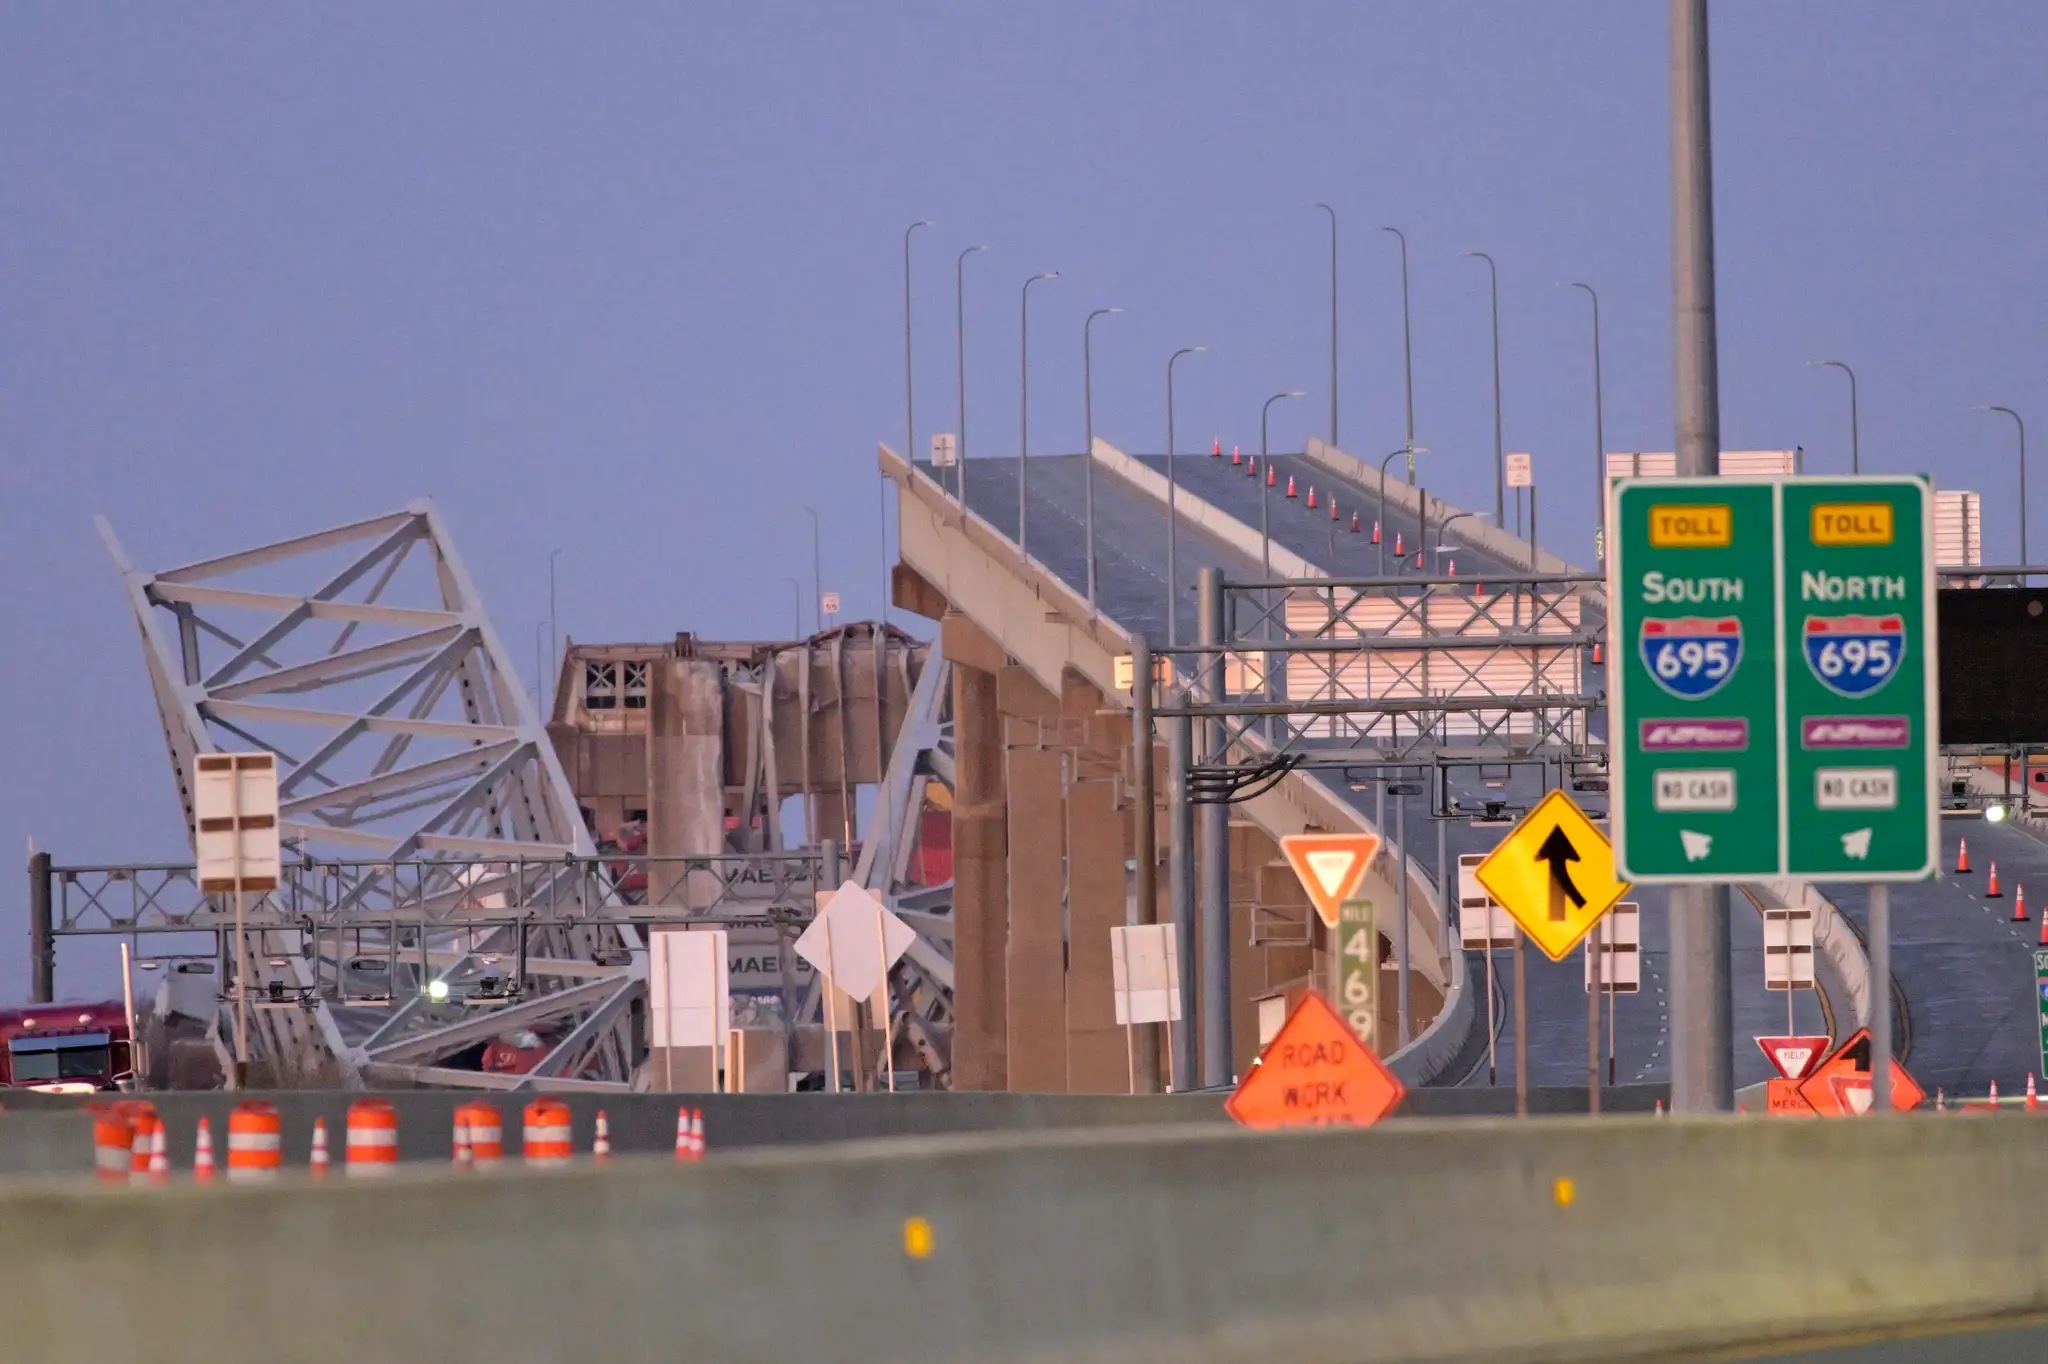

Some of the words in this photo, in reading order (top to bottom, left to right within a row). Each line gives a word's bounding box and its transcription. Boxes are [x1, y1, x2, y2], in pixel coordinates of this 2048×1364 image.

[1659, 516, 1721, 537] TOLL
[1821, 514, 1883, 535] TOLL
[1656, 641, 1729, 679] 695
[1819, 639, 1891, 677] 695
[1662, 782, 1682, 799] NO
[1689, 780, 1728, 799] CASH
[1824, 780, 1844, 797] NO
[1851, 778, 1889, 797] CASH
[1283, 1041, 1346, 1069] ROAD
[1784, 1051, 1805, 1060] YIELD
[1283, 1082, 1347, 1109] WORK
